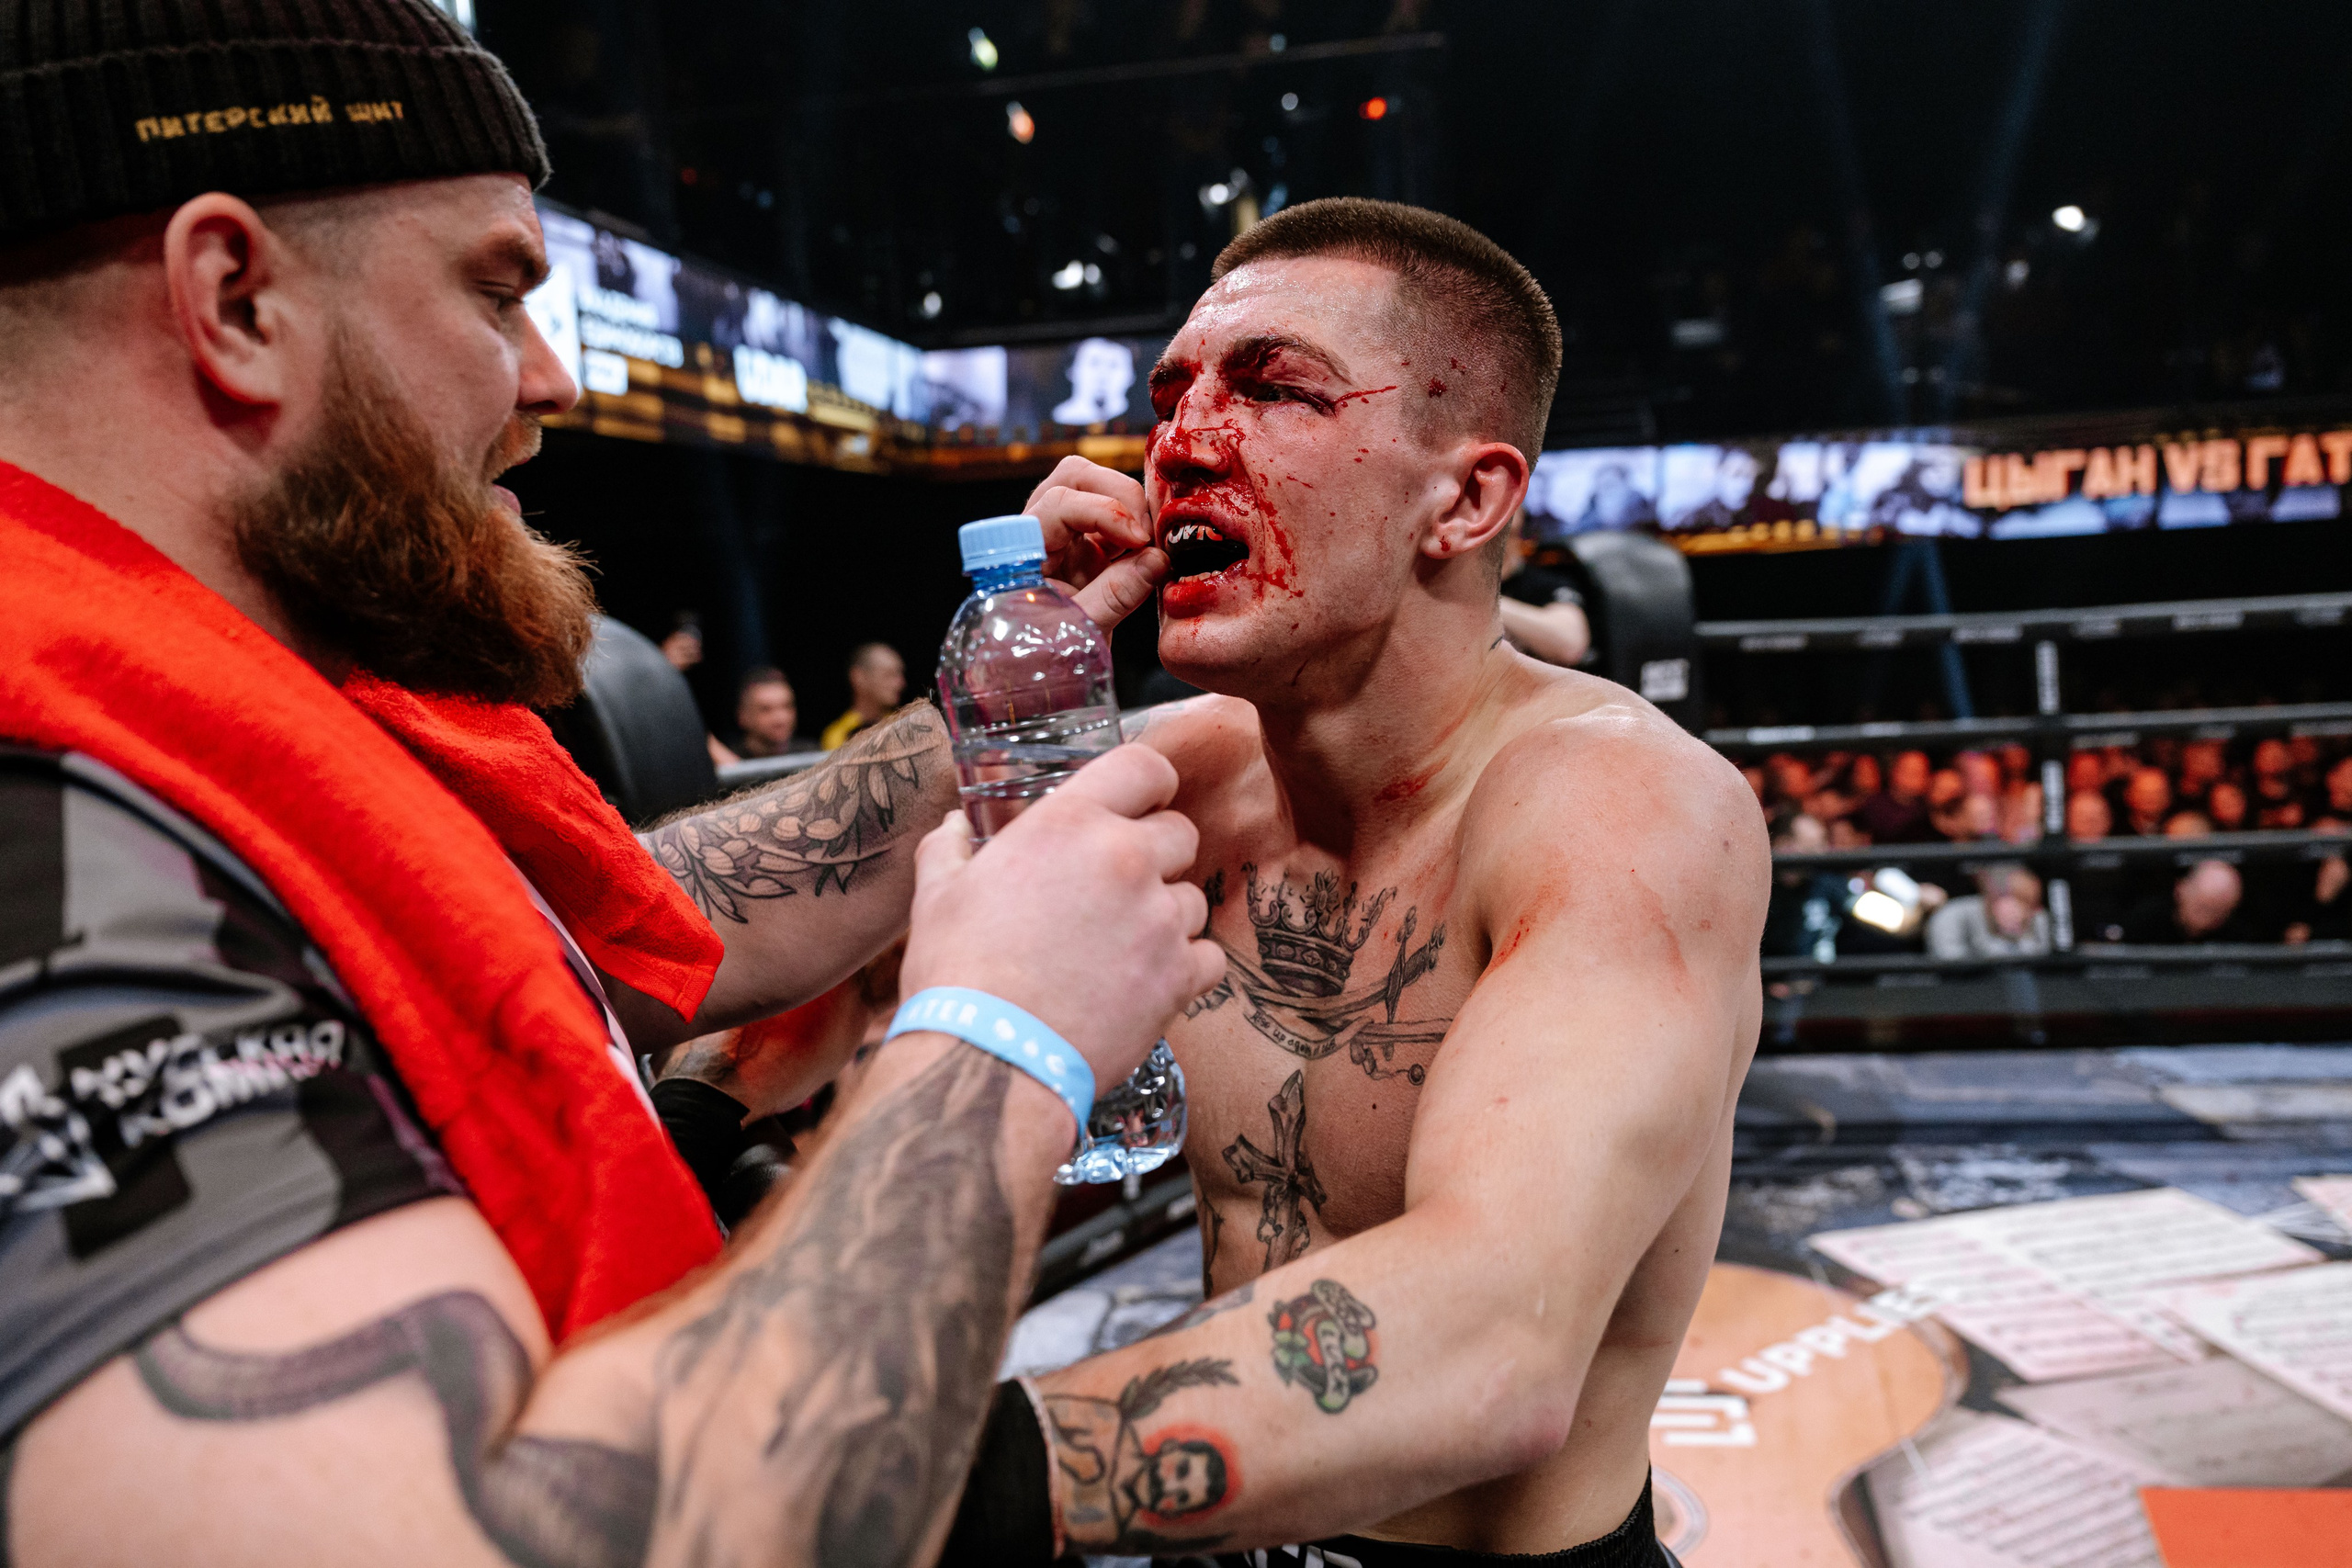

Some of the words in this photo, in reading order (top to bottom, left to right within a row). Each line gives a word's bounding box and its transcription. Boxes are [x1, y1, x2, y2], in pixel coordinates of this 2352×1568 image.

[135, 94, 334, 141] ПИТЕРСКИЙ
[1962, 443, 2158, 511] ЦЫГАН
[2163, 437, 2242, 493] VS
